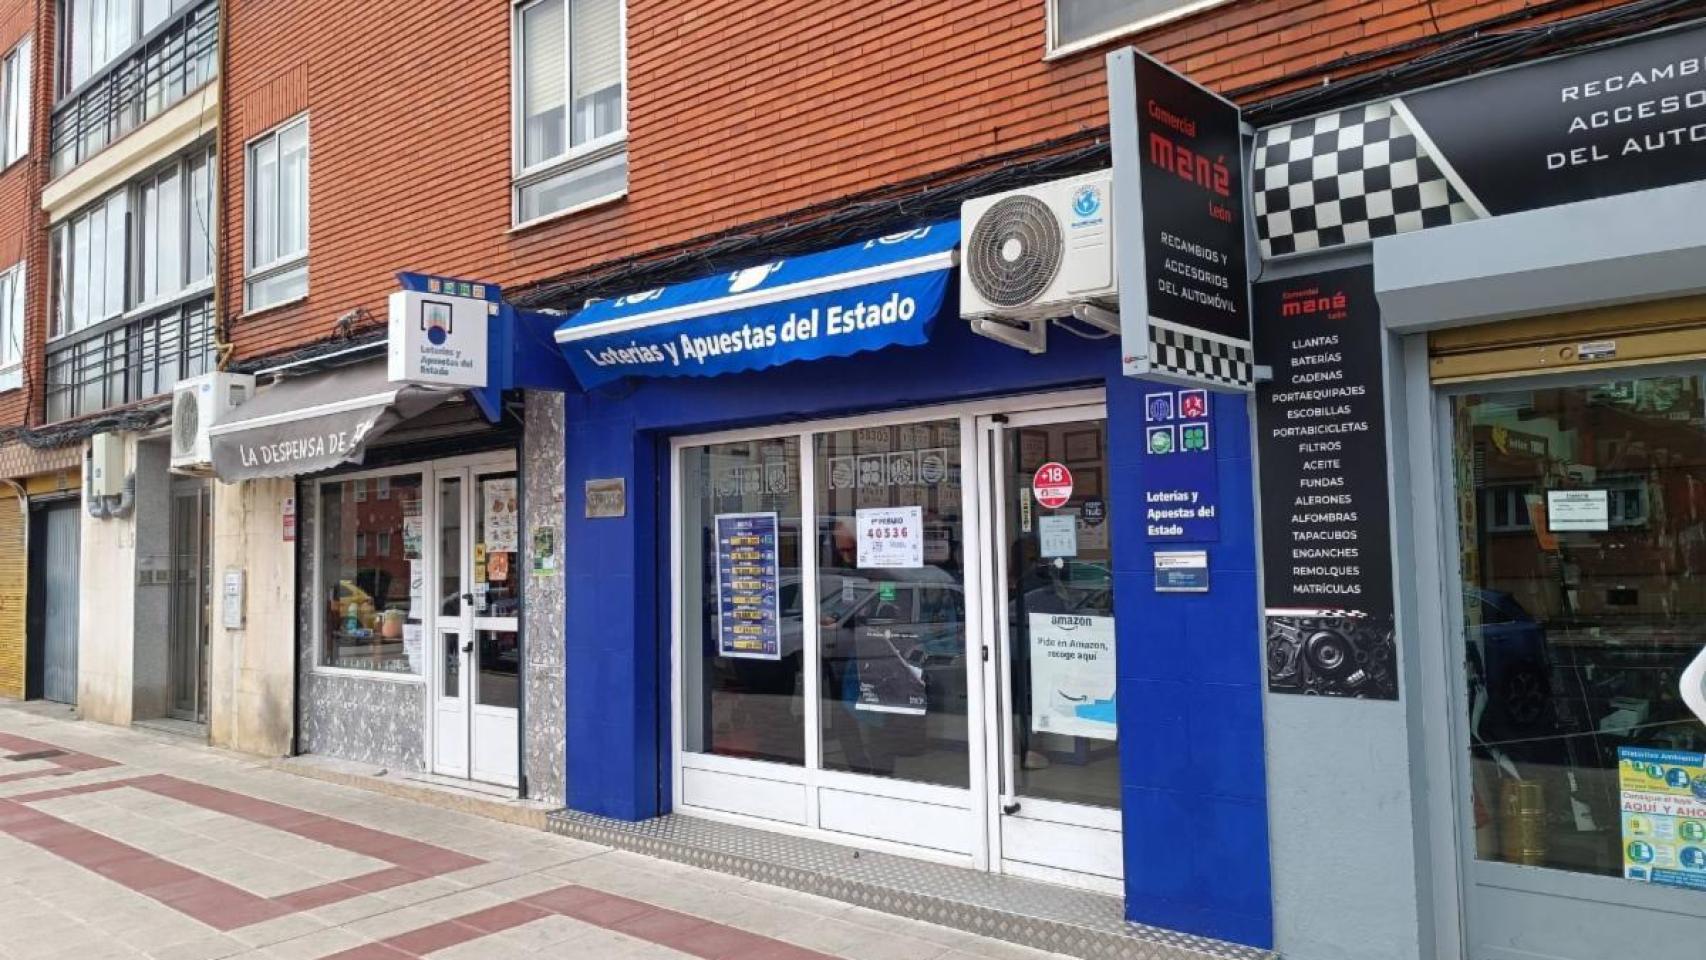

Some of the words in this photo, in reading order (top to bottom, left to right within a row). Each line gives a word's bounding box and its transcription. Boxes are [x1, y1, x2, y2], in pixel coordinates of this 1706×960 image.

[1148, 99, 1197, 138] Comercial
[1568, 90, 1706, 134] ACCESO
[1149, 131, 1230, 197] mané
[1546, 145, 1608, 170] DEL
[1208, 199, 1232, 223] León
[1160, 231, 1219, 263] RECAMBIOS
[1221, 254, 1229, 266] Y
[1164, 258, 1229, 289] ACCESORIOS
[1158, 278, 1178, 298] DEL
[1180, 286, 1237, 313] AUTOMÓVIL
[1282, 291, 1346, 317] mané
[585, 338, 664, 367] Loterías
[663, 342, 679, 367] y
[682, 323, 777, 364] Apuestas
[781, 308, 818, 343] del
[826, 292, 916, 336] Estado
[1292, 335, 1339, 350] LLANTAS
[1291, 352, 1342, 367] BATERÍAS
[1291, 370, 1343, 384] CADENAS
[1272, 385, 1366, 403] PORTAEQUIPAJES
[1287, 405, 1352, 419] ESCOBILLAS
[1273, 422, 1369, 438] PORTABICICLETAS
[240, 443, 258, 467] LA
[260, 436, 325, 465] DESPENSA
[329, 431, 347, 454] DE
[1298, 441, 1342, 453] FILTROS
[1303, 459, 1340, 471] ACEITE
[1040, 467, 1063, 482] +18
[1300, 477, 1344, 489] FUNDAS
[1146, 491, 1188, 503] Loterías
[1192, 491, 1199, 503] y
[1294, 494, 1353, 506] ALERONES
[1147, 508, 1195, 521] Apuestas
[1197, 505, 1215, 517] del
[1291, 512, 1358, 523] ALFOMBRAS
[866, 527, 908, 539] 40536
[1147, 524, 1184, 536] Estado
[1292, 530, 1358, 540] TAPACUBOS
[1292, 548, 1359, 559] ENGANCHES
[1293, 565, 1360, 577] REMOLQUES
[1293, 582, 1361, 594] MATRÍCULAS
[1051, 615, 1093, 627] amazon
[1037, 636, 1056, 647] Pide
[1057, 640, 1067, 648] en
[1047, 651, 1076, 661] recoge
